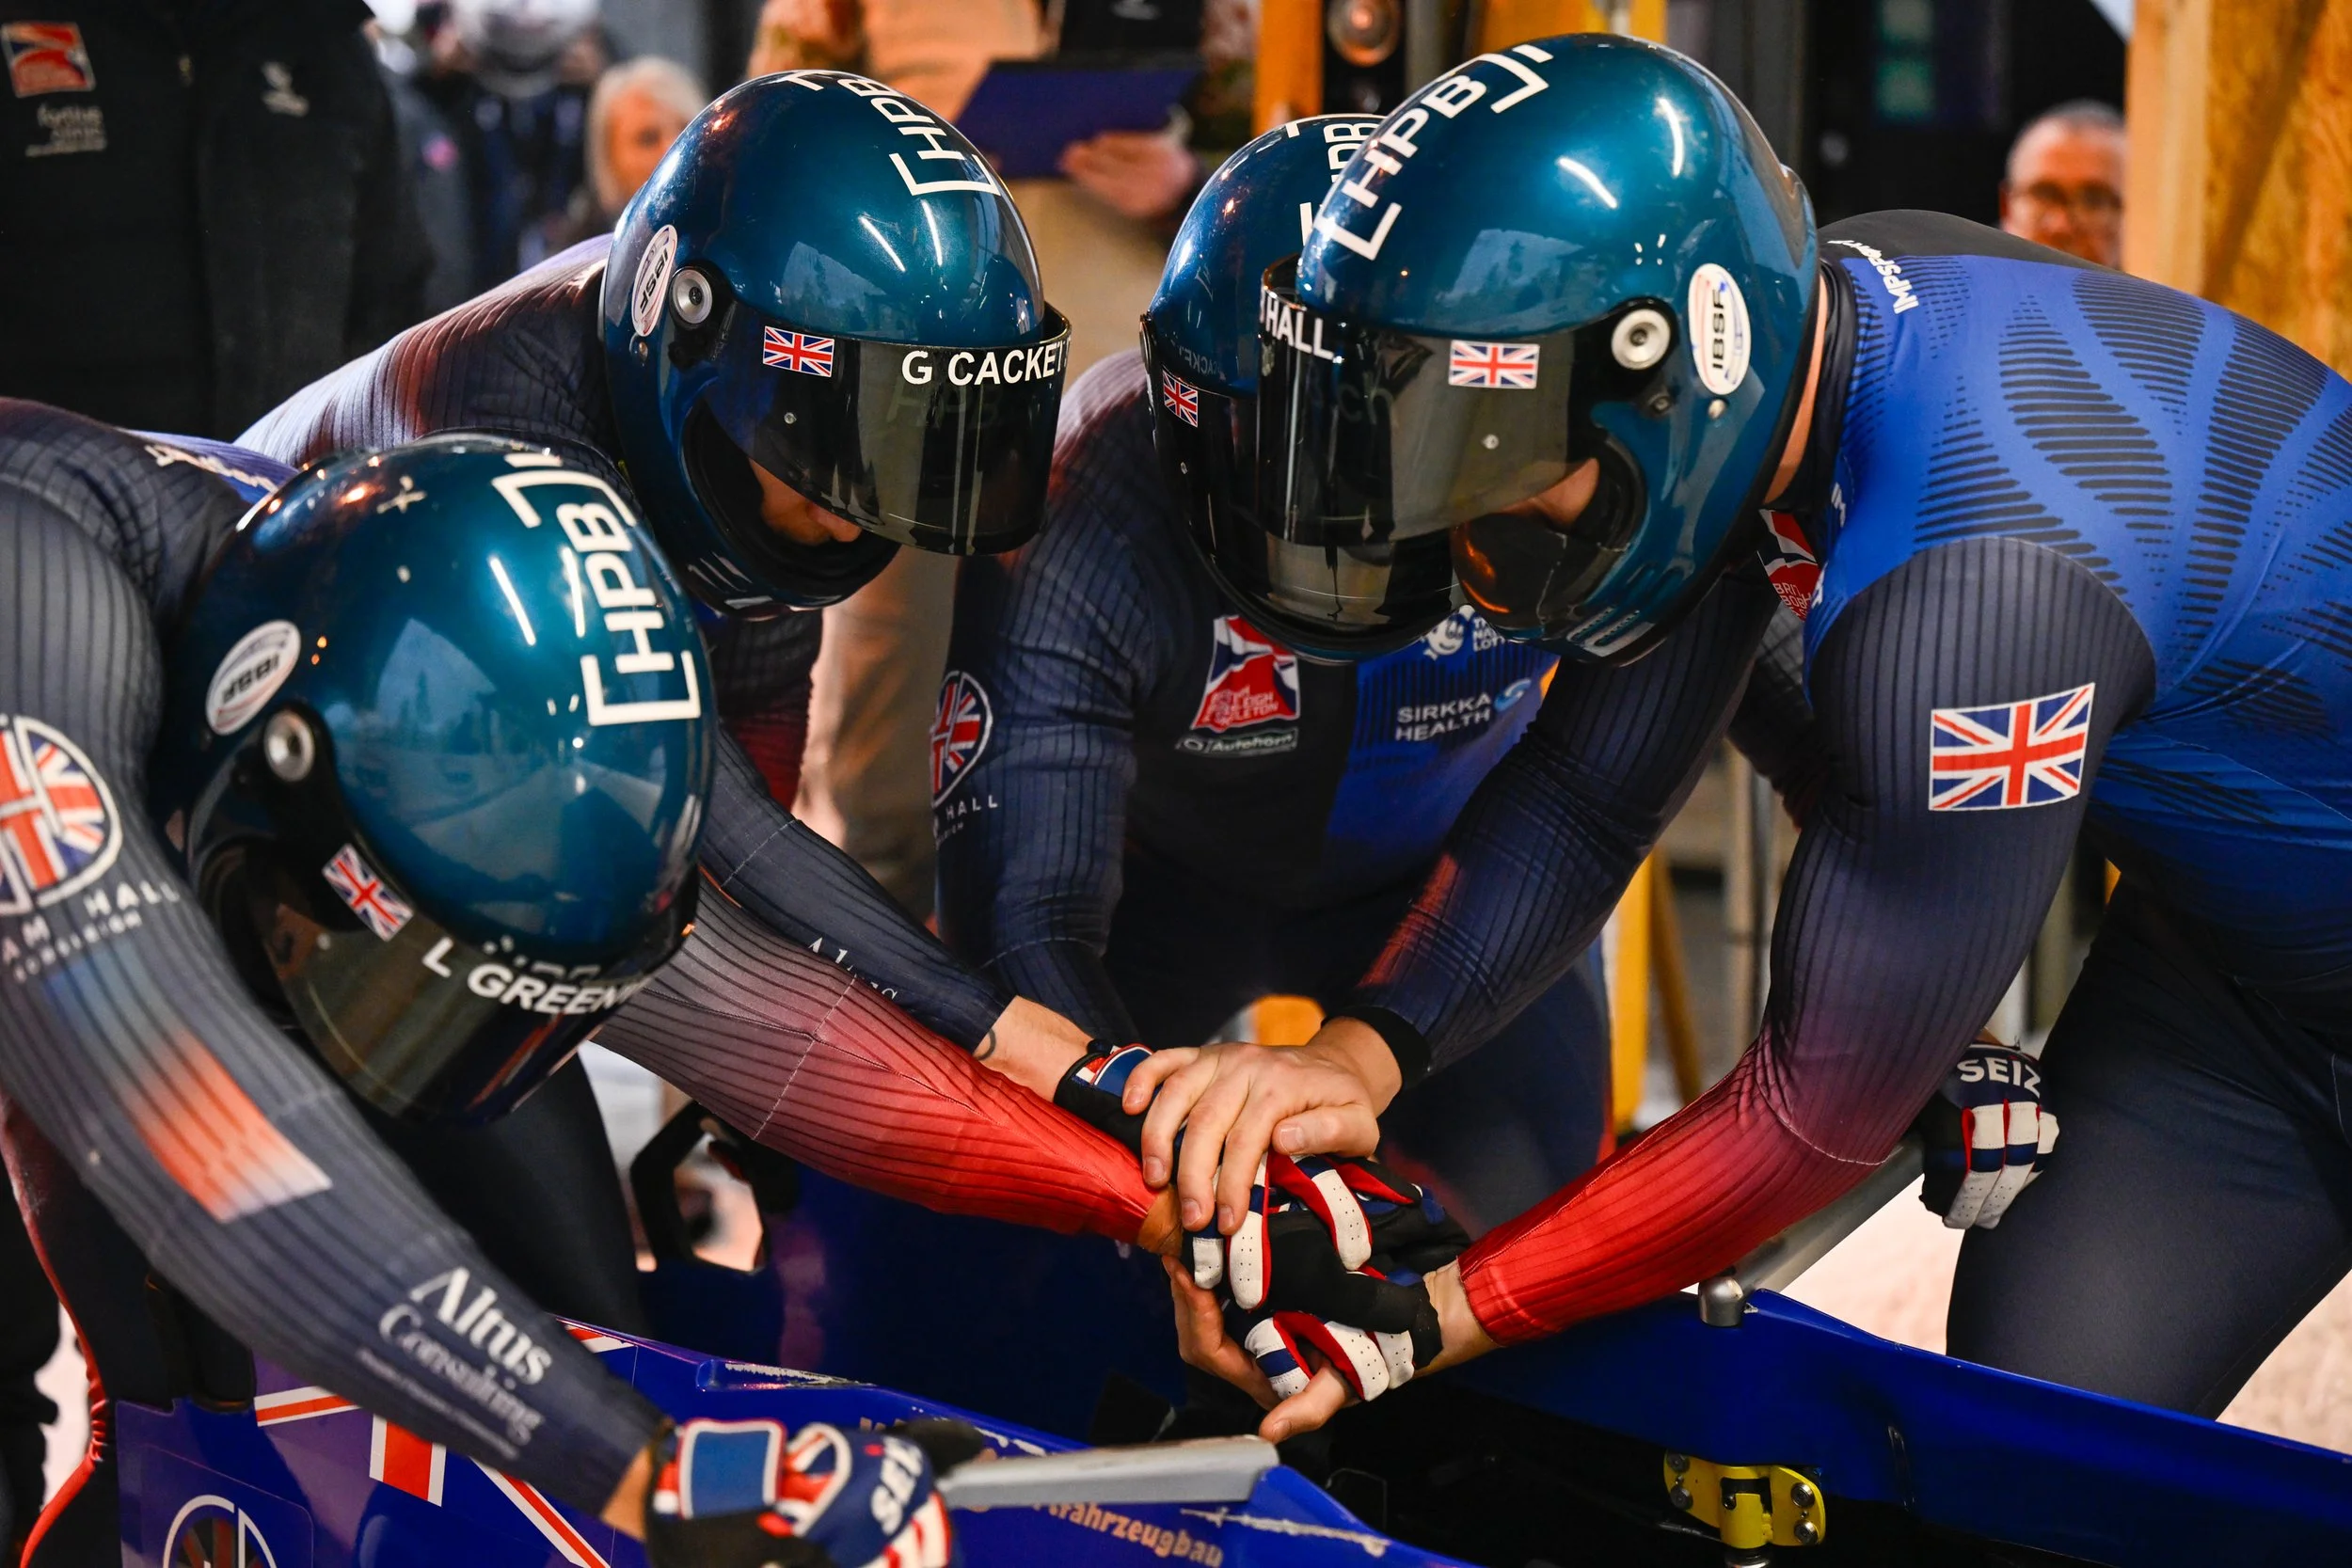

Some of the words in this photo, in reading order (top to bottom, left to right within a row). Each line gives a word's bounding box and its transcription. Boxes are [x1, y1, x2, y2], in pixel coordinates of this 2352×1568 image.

[640, 247, 669, 314] IBSF
[1712, 288, 1725, 370] IBSF
[901, 350, 933, 385] G
[1395, 708, 1491, 741] HEALTH
[1397, 692, 1492, 723] SIRKKA
[83, 880, 181, 918] HALL
[422, 937, 453, 978] L
[408, 1266, 552, 1386] Altus
